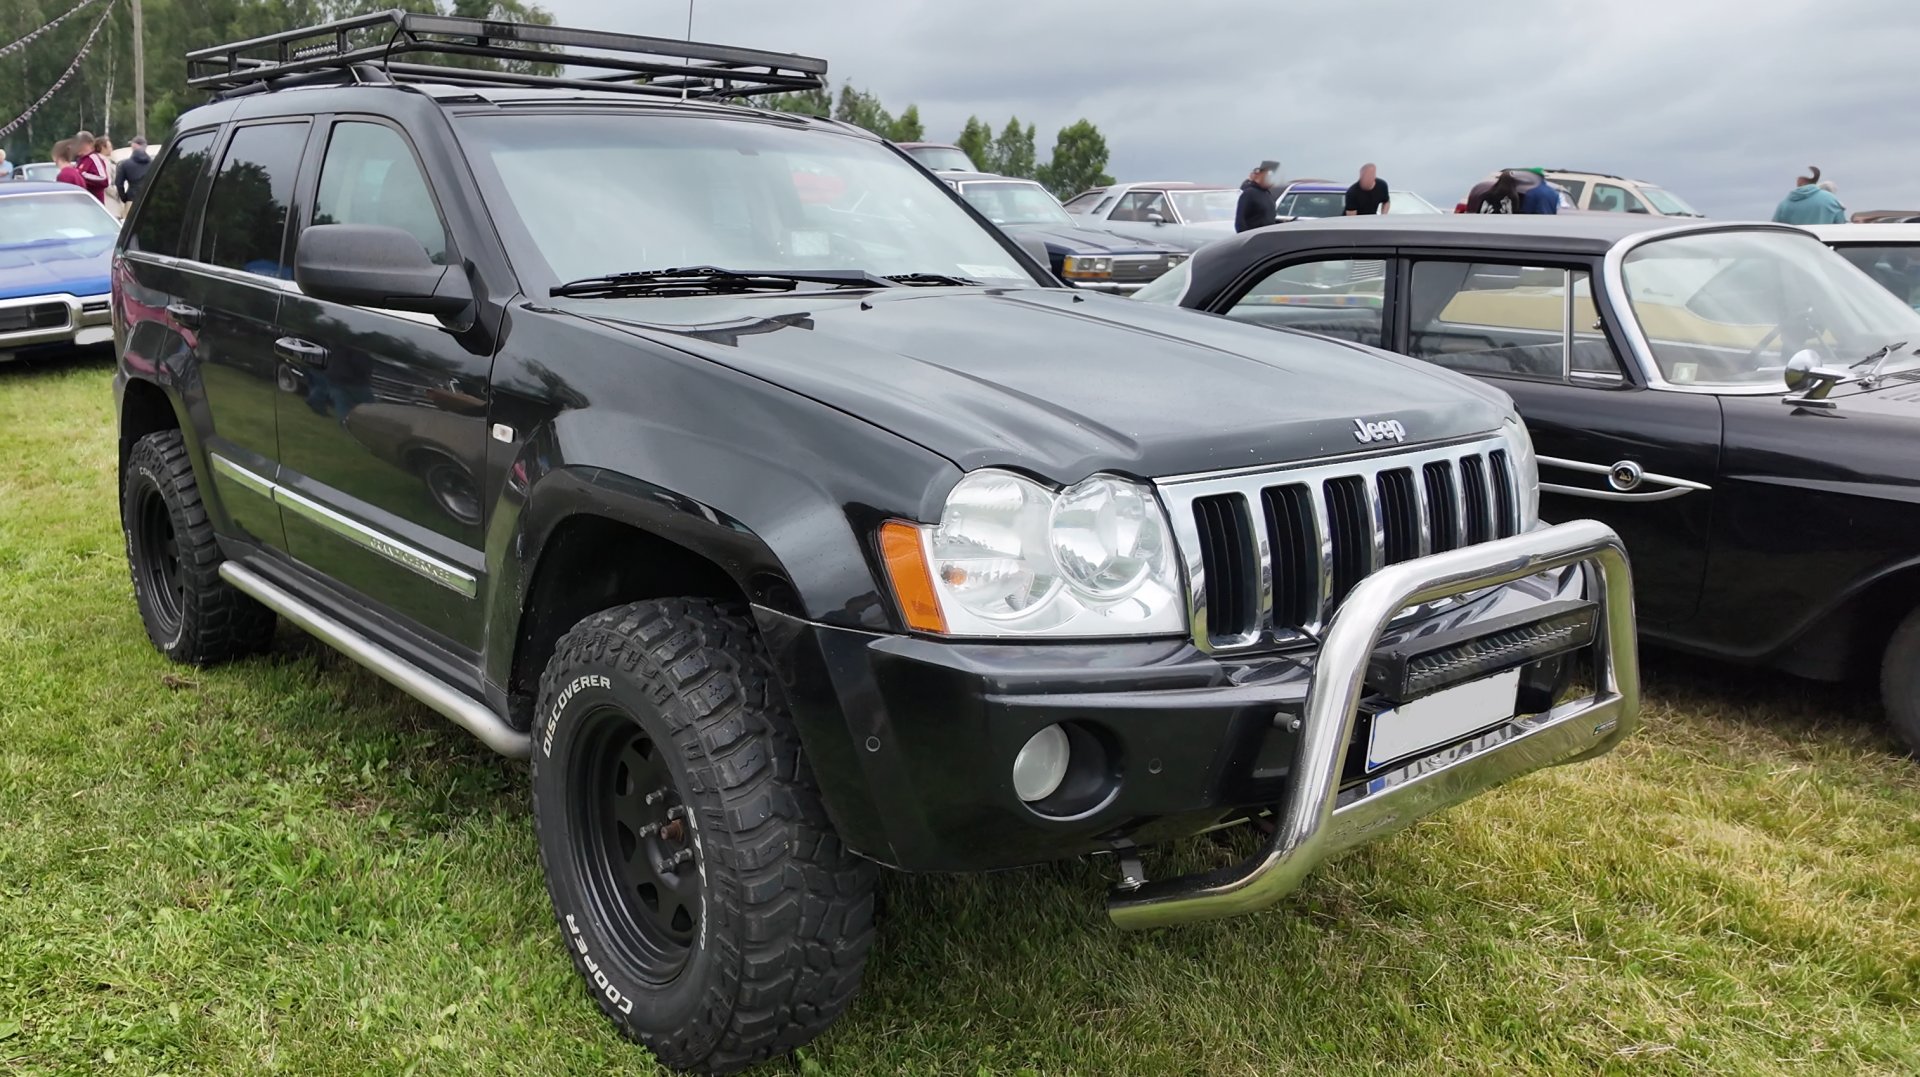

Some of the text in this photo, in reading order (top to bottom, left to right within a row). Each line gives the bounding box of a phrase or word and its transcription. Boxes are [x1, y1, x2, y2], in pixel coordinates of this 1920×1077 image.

[1353, 418, 1406, 443] Jeep
[543, 675, 612, 758] DISCOVERER
[686, 805, 708, 887] STT
[566, 913, 633, 1015] COOPER
